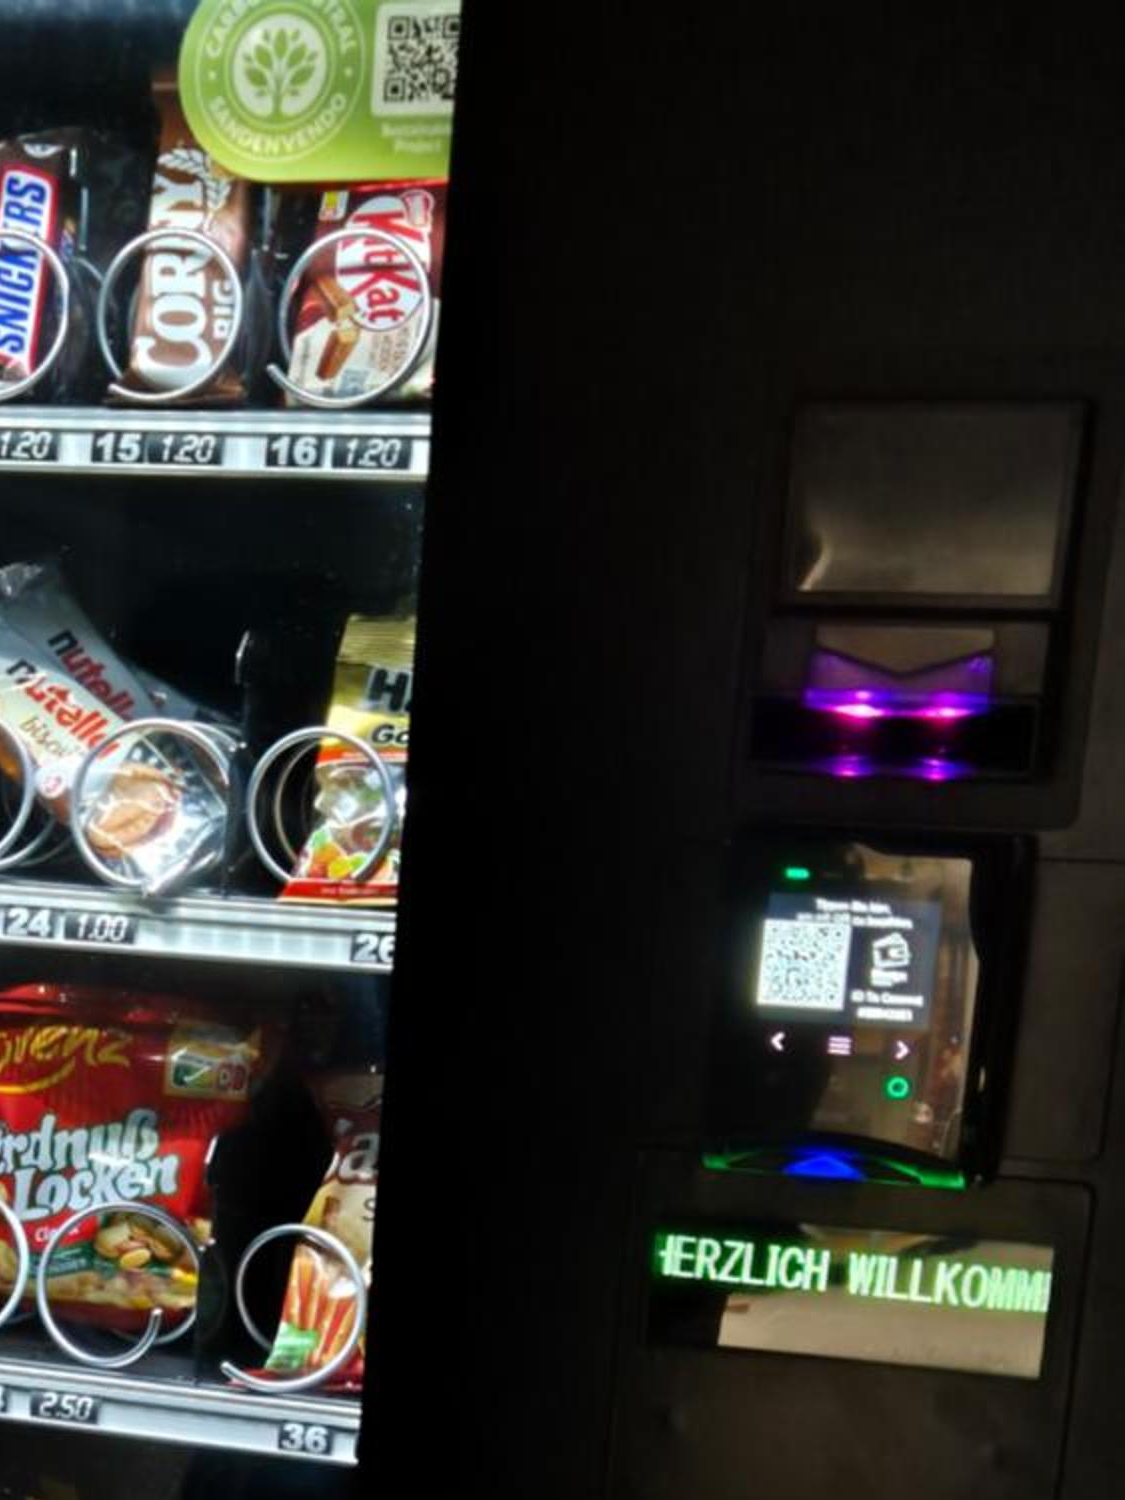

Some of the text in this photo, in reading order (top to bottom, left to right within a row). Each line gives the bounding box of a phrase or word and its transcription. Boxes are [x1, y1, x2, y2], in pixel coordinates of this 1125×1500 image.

[0, 432, 52, 460] 1.20
[96, 433, 216, 463] 15 1.20
[271, 436, 401, 467] 16 1.20
[7, 908, 129, 942] 24 1.00
[13, 1153, 180, 1220] Locken
[281, 1423, 329, 1454] 36
